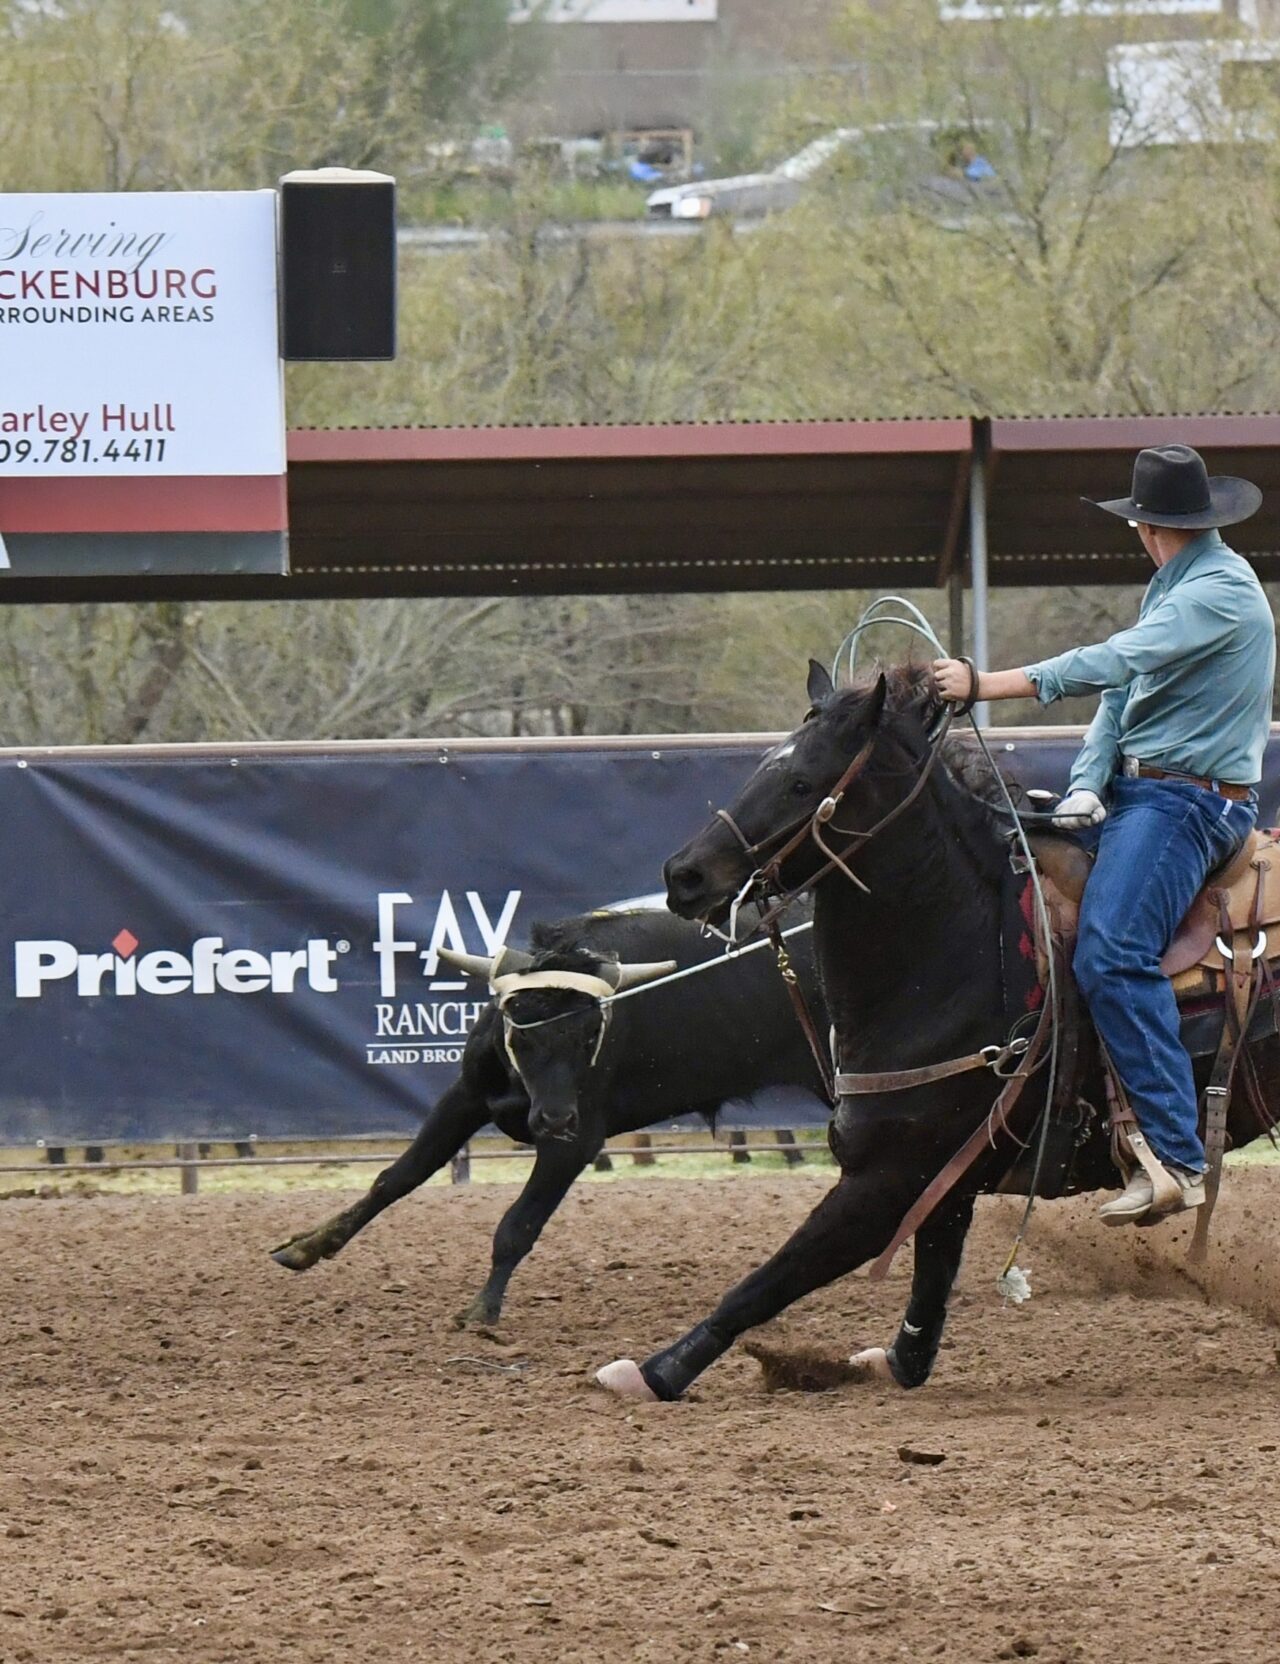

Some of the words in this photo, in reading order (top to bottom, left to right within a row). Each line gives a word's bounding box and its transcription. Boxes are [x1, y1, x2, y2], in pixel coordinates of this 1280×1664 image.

[0, 210, 175, 275] Serving
[0, 269, 217, 300] CKENBURG
[141, 305, 215, 322] AREAS
[102, 404, 176, 432] Hull
[372, 889, 522, 998] FAY
[374, 1002, 490, 1036] RANCH
[366, 1049, 420, 1065] LAND
[422, 1048, 466, 1064] BRO
